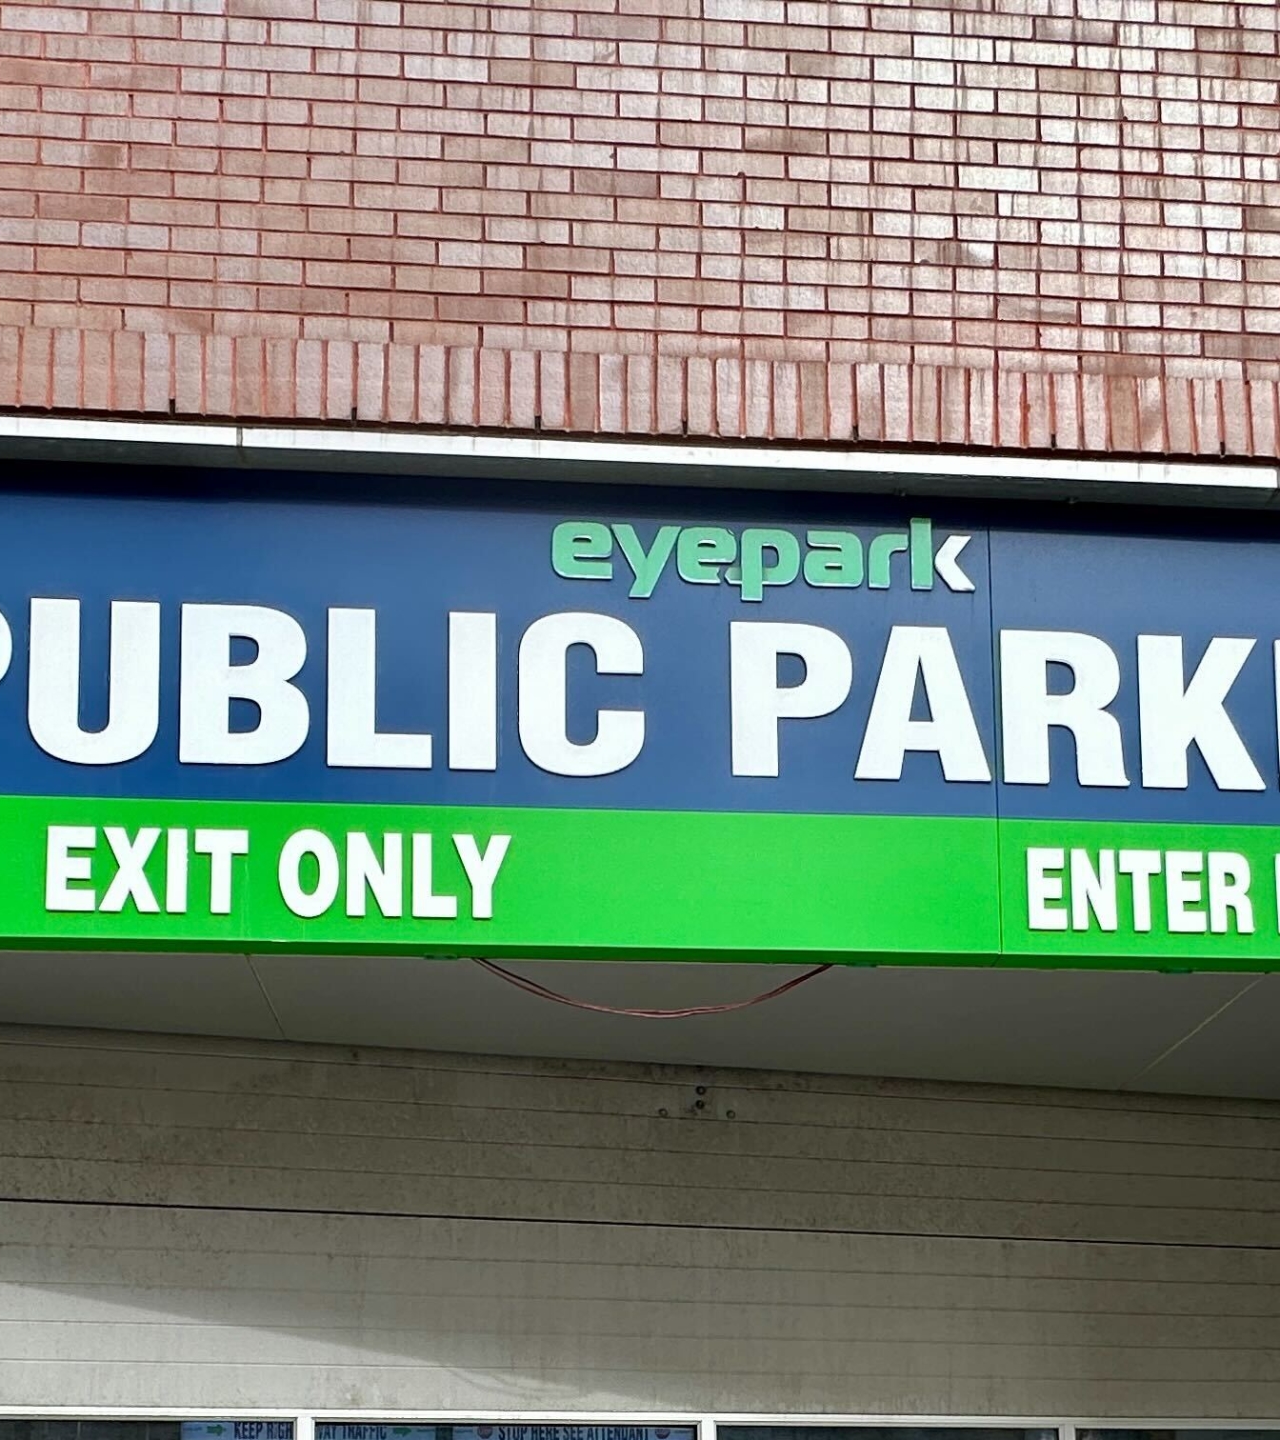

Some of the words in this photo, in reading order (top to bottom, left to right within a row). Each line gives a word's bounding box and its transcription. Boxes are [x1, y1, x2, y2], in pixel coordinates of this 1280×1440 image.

[552, 516, 977, 602] eyepark
[44, 824, 249, 915] EXIT
[277, 827, 512, 920] ONLY
[1025, 846, 1255, 934] ENTER
[233, 1421, 263, 1440] KEEP
[266, 1421, 294, 1440] RIGH
[498, 1426, 528, 1440] STOP
[531, 1426, 560, 1440] HERE
[562, 1427, 584, 1440] SEE
[586, 1427, 649, 1440] ATTENDANT
